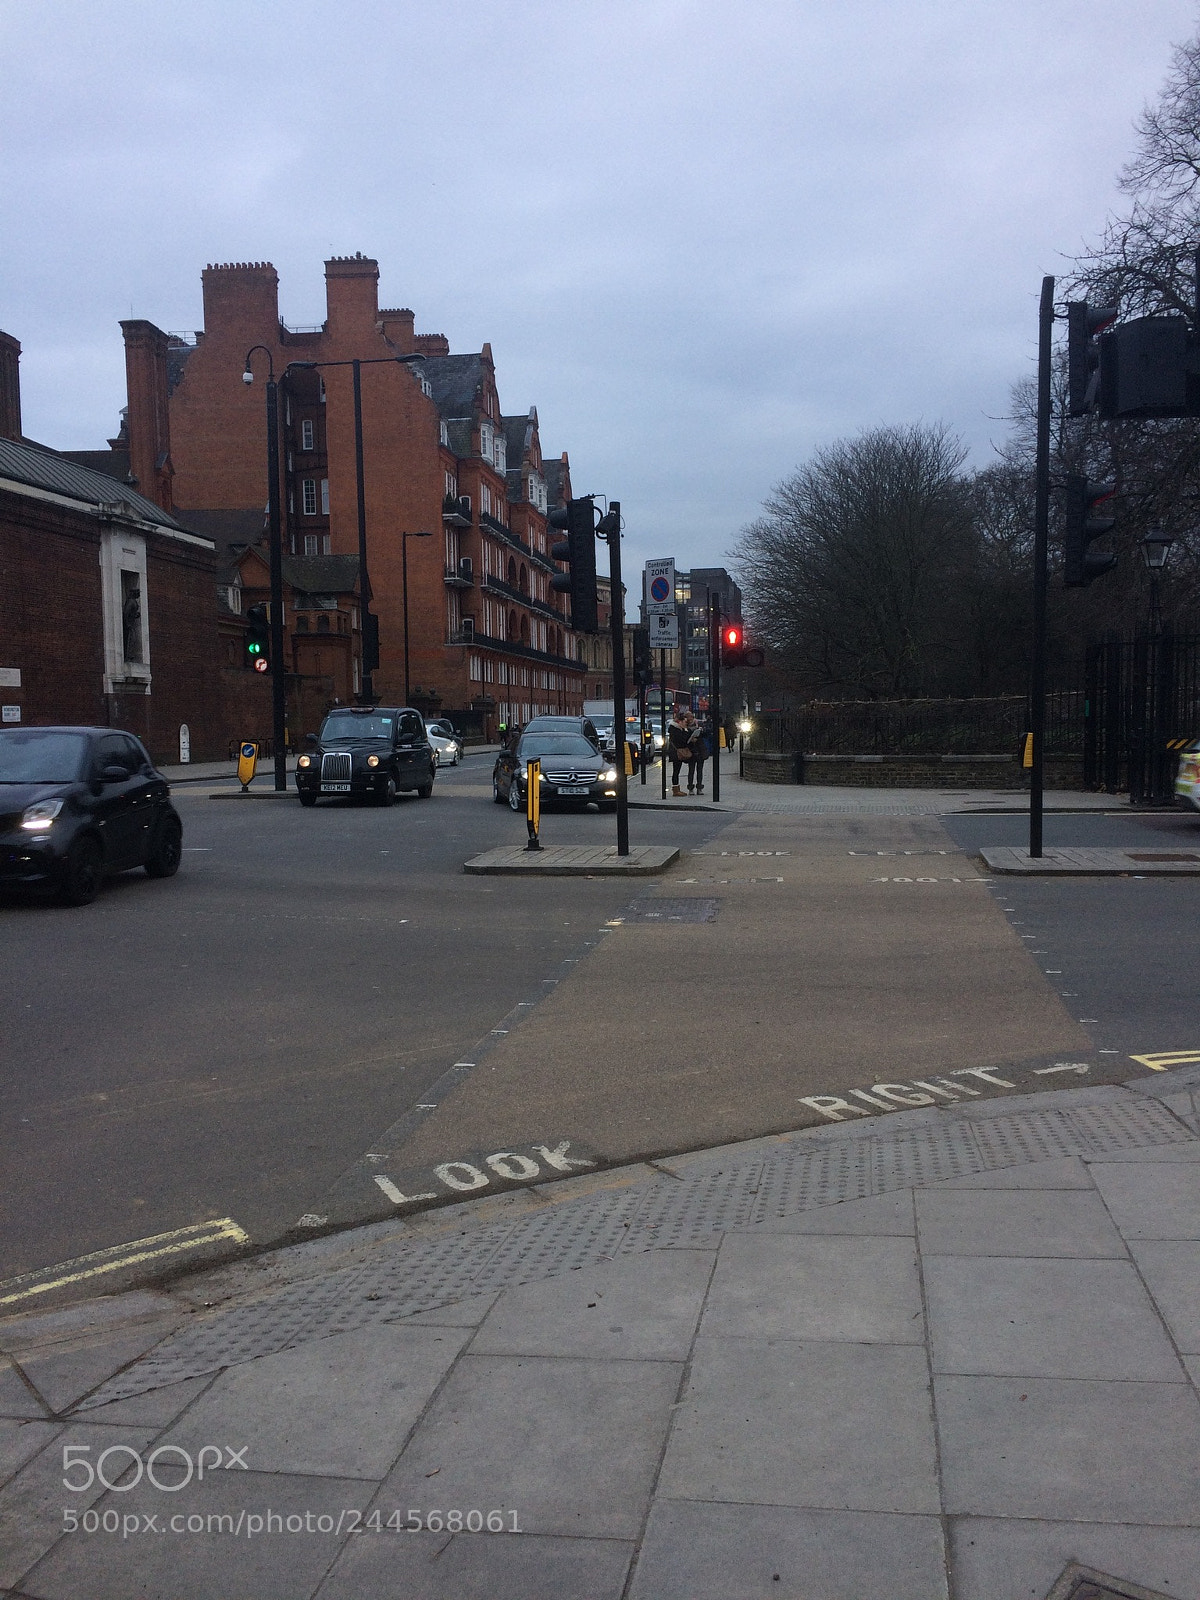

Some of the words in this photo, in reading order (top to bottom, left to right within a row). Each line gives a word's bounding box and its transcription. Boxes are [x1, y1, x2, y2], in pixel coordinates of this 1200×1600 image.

[651, 567, 669, 576] ZONE
[372, 1140, 595, 1206] LOOK
[799, 1065, 1017, 1121] RIGHT
